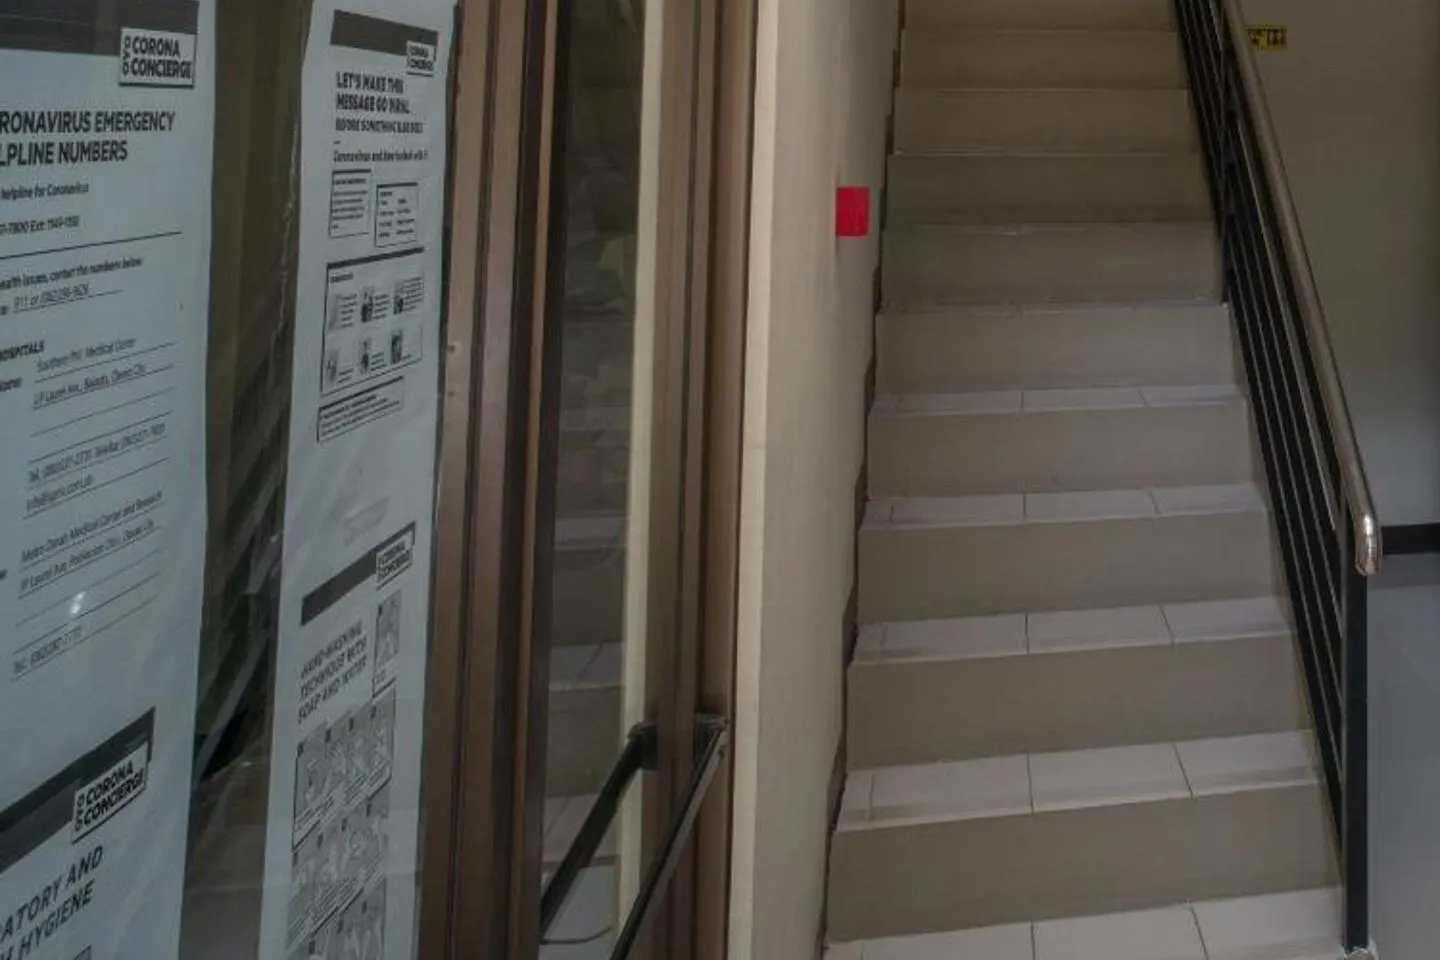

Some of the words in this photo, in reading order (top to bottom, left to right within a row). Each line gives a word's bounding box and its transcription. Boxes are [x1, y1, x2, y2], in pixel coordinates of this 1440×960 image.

[132, 36, 181, 58] CORONA
[131, 58, 192, 79] CONCIERGE
[0, 110, 91, 134] RONAVIRUS
[95, 111, 176, 132] EMERGENCY
[58, 141, 128, 163] NUMBERS
[83, 768, 145, 826] CONCIERGE
[86, 759, 134, 805] CORONA
[65, 844, 104, 890] AND
[18, 877, 95, 960] HYGIENE
